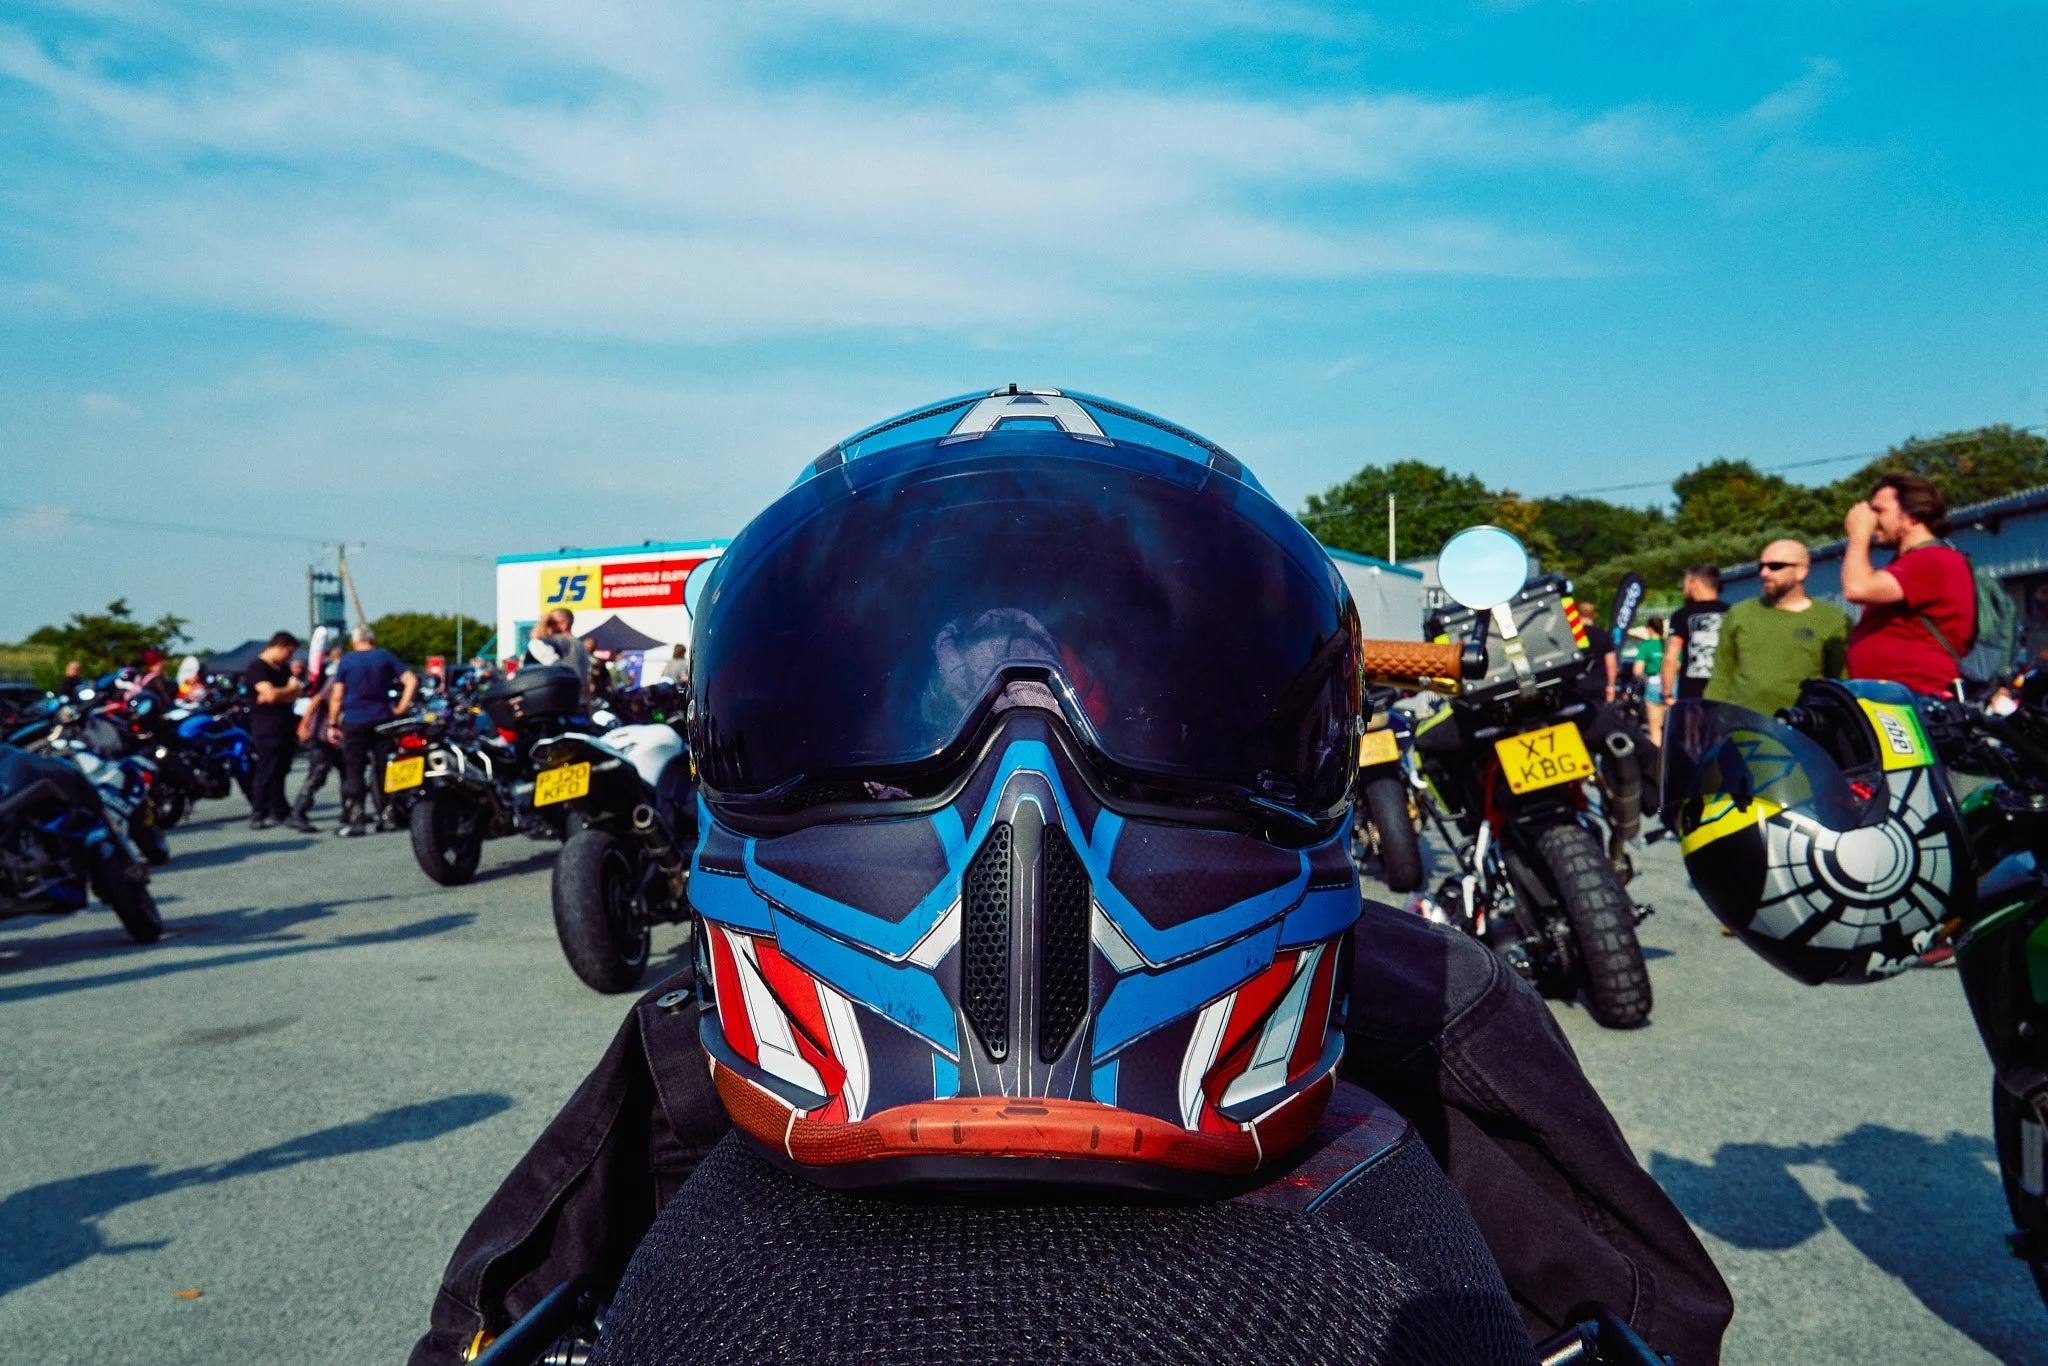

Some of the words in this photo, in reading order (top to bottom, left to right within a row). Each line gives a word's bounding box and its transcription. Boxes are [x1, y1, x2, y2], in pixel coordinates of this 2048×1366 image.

[547, 574, 588, 603] JS
[1518, 731, 1554, 759] X7
[539, 765, 587, 788] PJ20
[1520, 754, 1577, 784] KBG
